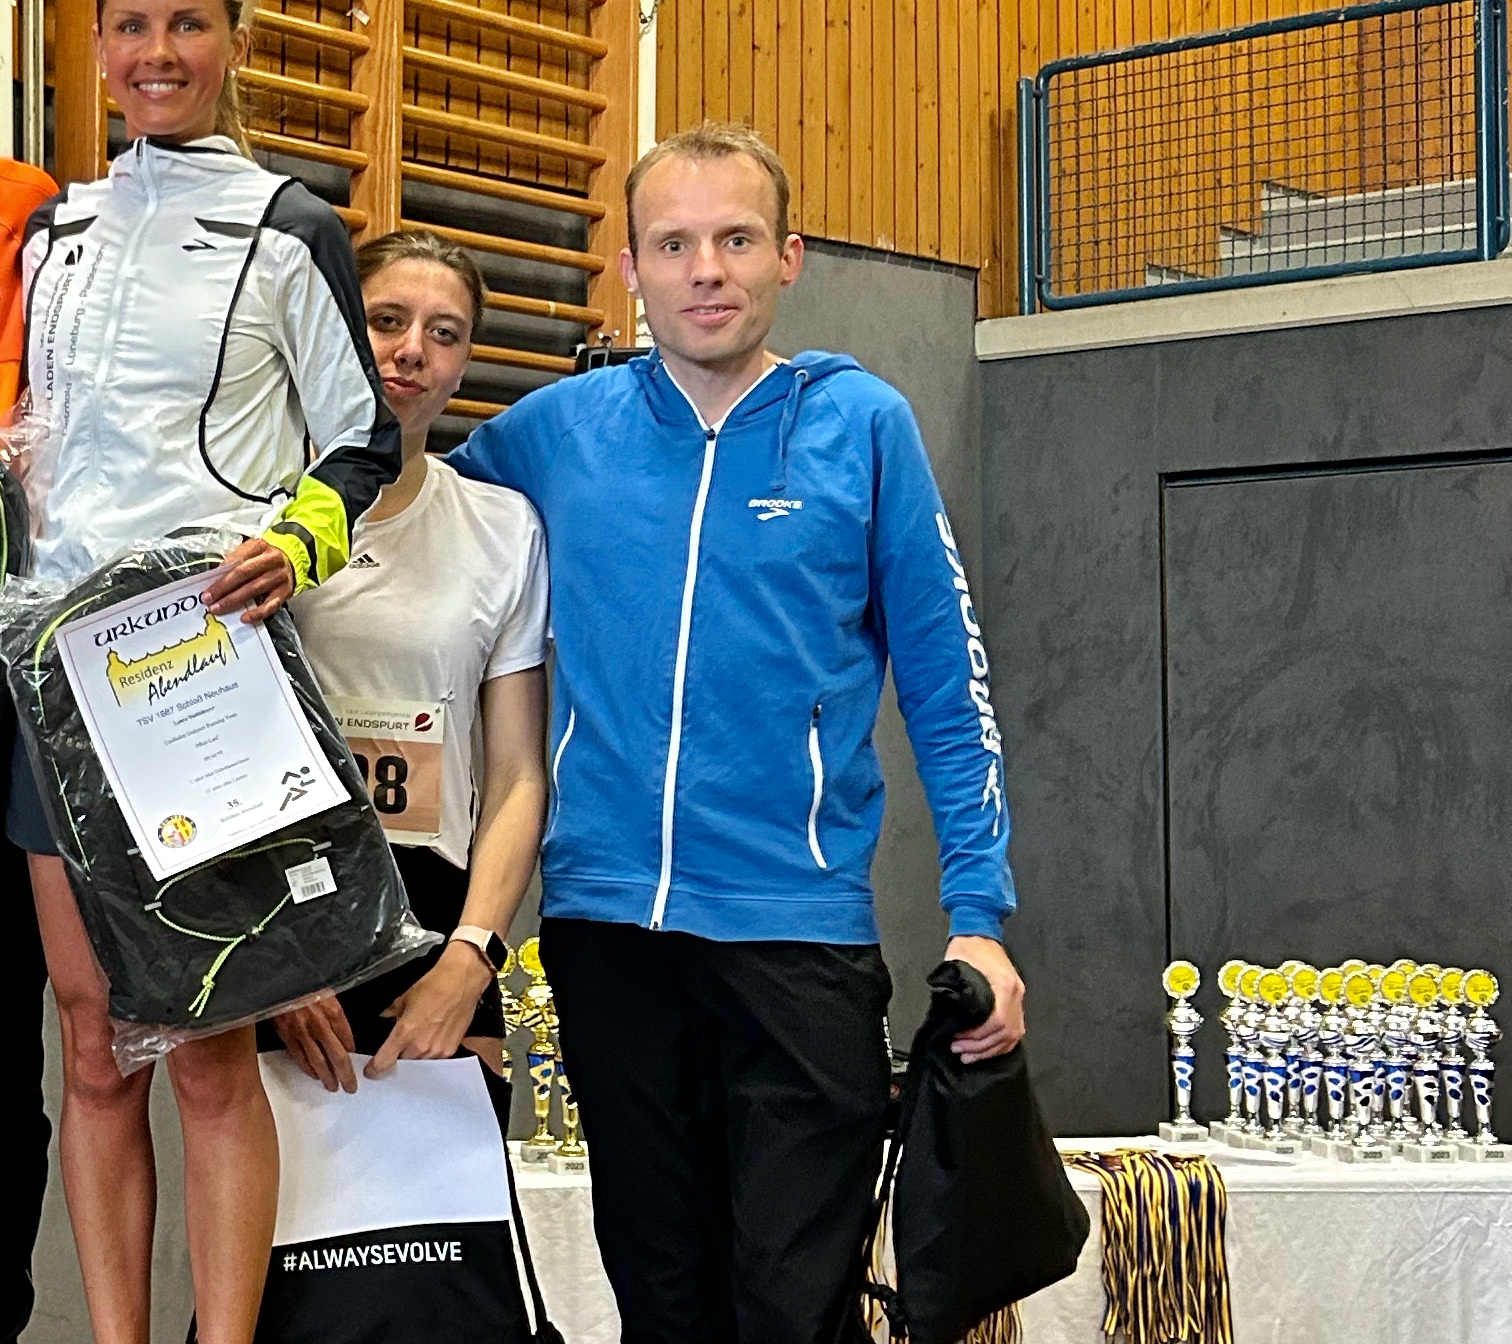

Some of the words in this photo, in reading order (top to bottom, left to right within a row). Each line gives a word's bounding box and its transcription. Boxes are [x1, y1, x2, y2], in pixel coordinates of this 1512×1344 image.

[47, 272, 75, 344] ENDSPURT
[748, 499, 803, 510] BROOKS
[118, 659, 175, 689] Residenz
[147, 638, 228, 706] Abendlauf
[136, 715, 154, 727] TSV
[203, 681, 240, 701] Neuhaus
[347, 718, 410, 731] ENDSPURT
[283, 1241, 462, 1271] #ALWAYSEVOLVE
